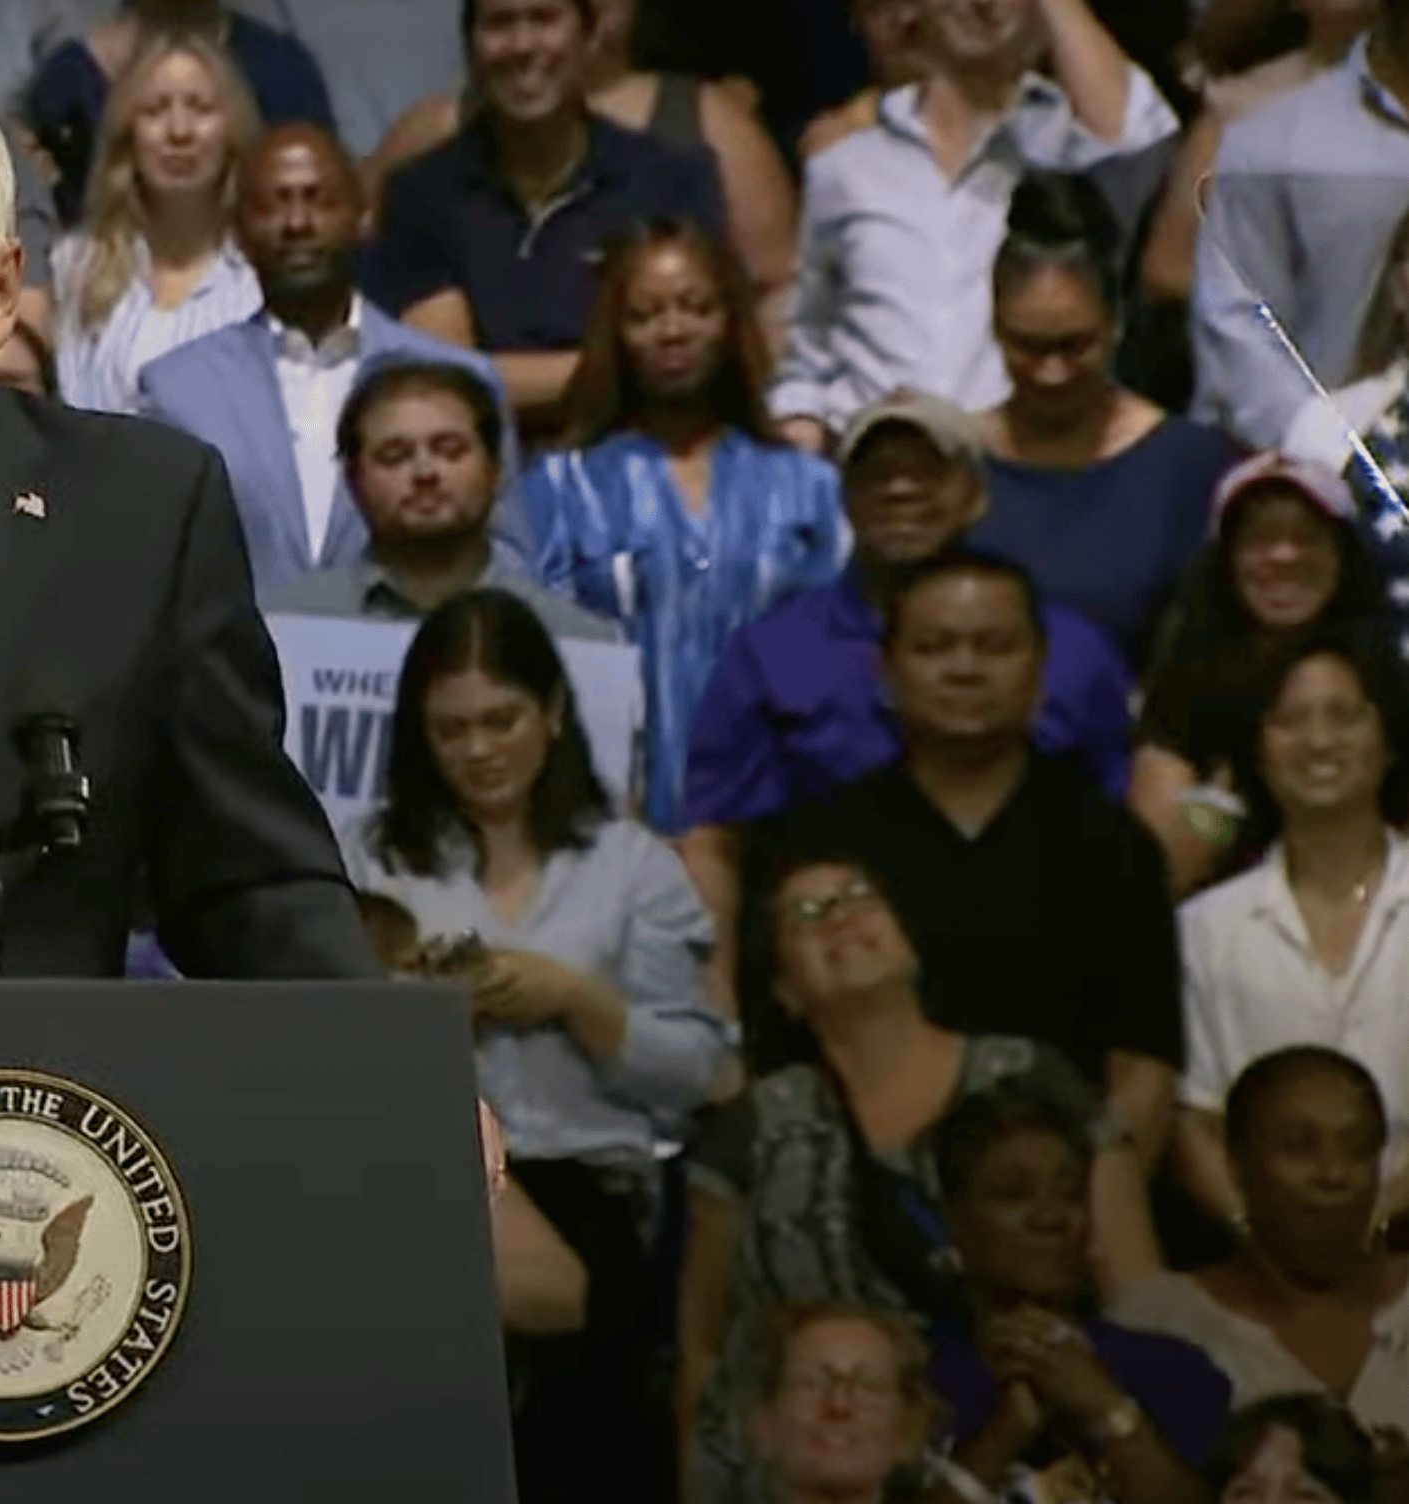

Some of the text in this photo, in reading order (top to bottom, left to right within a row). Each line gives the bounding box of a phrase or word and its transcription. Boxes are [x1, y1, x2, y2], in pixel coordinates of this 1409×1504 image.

[0, 1086, 63, 1118] THE
[79, 1104, 179, 1253] UNITED
[67, 1278, 177, 1414] STATES
